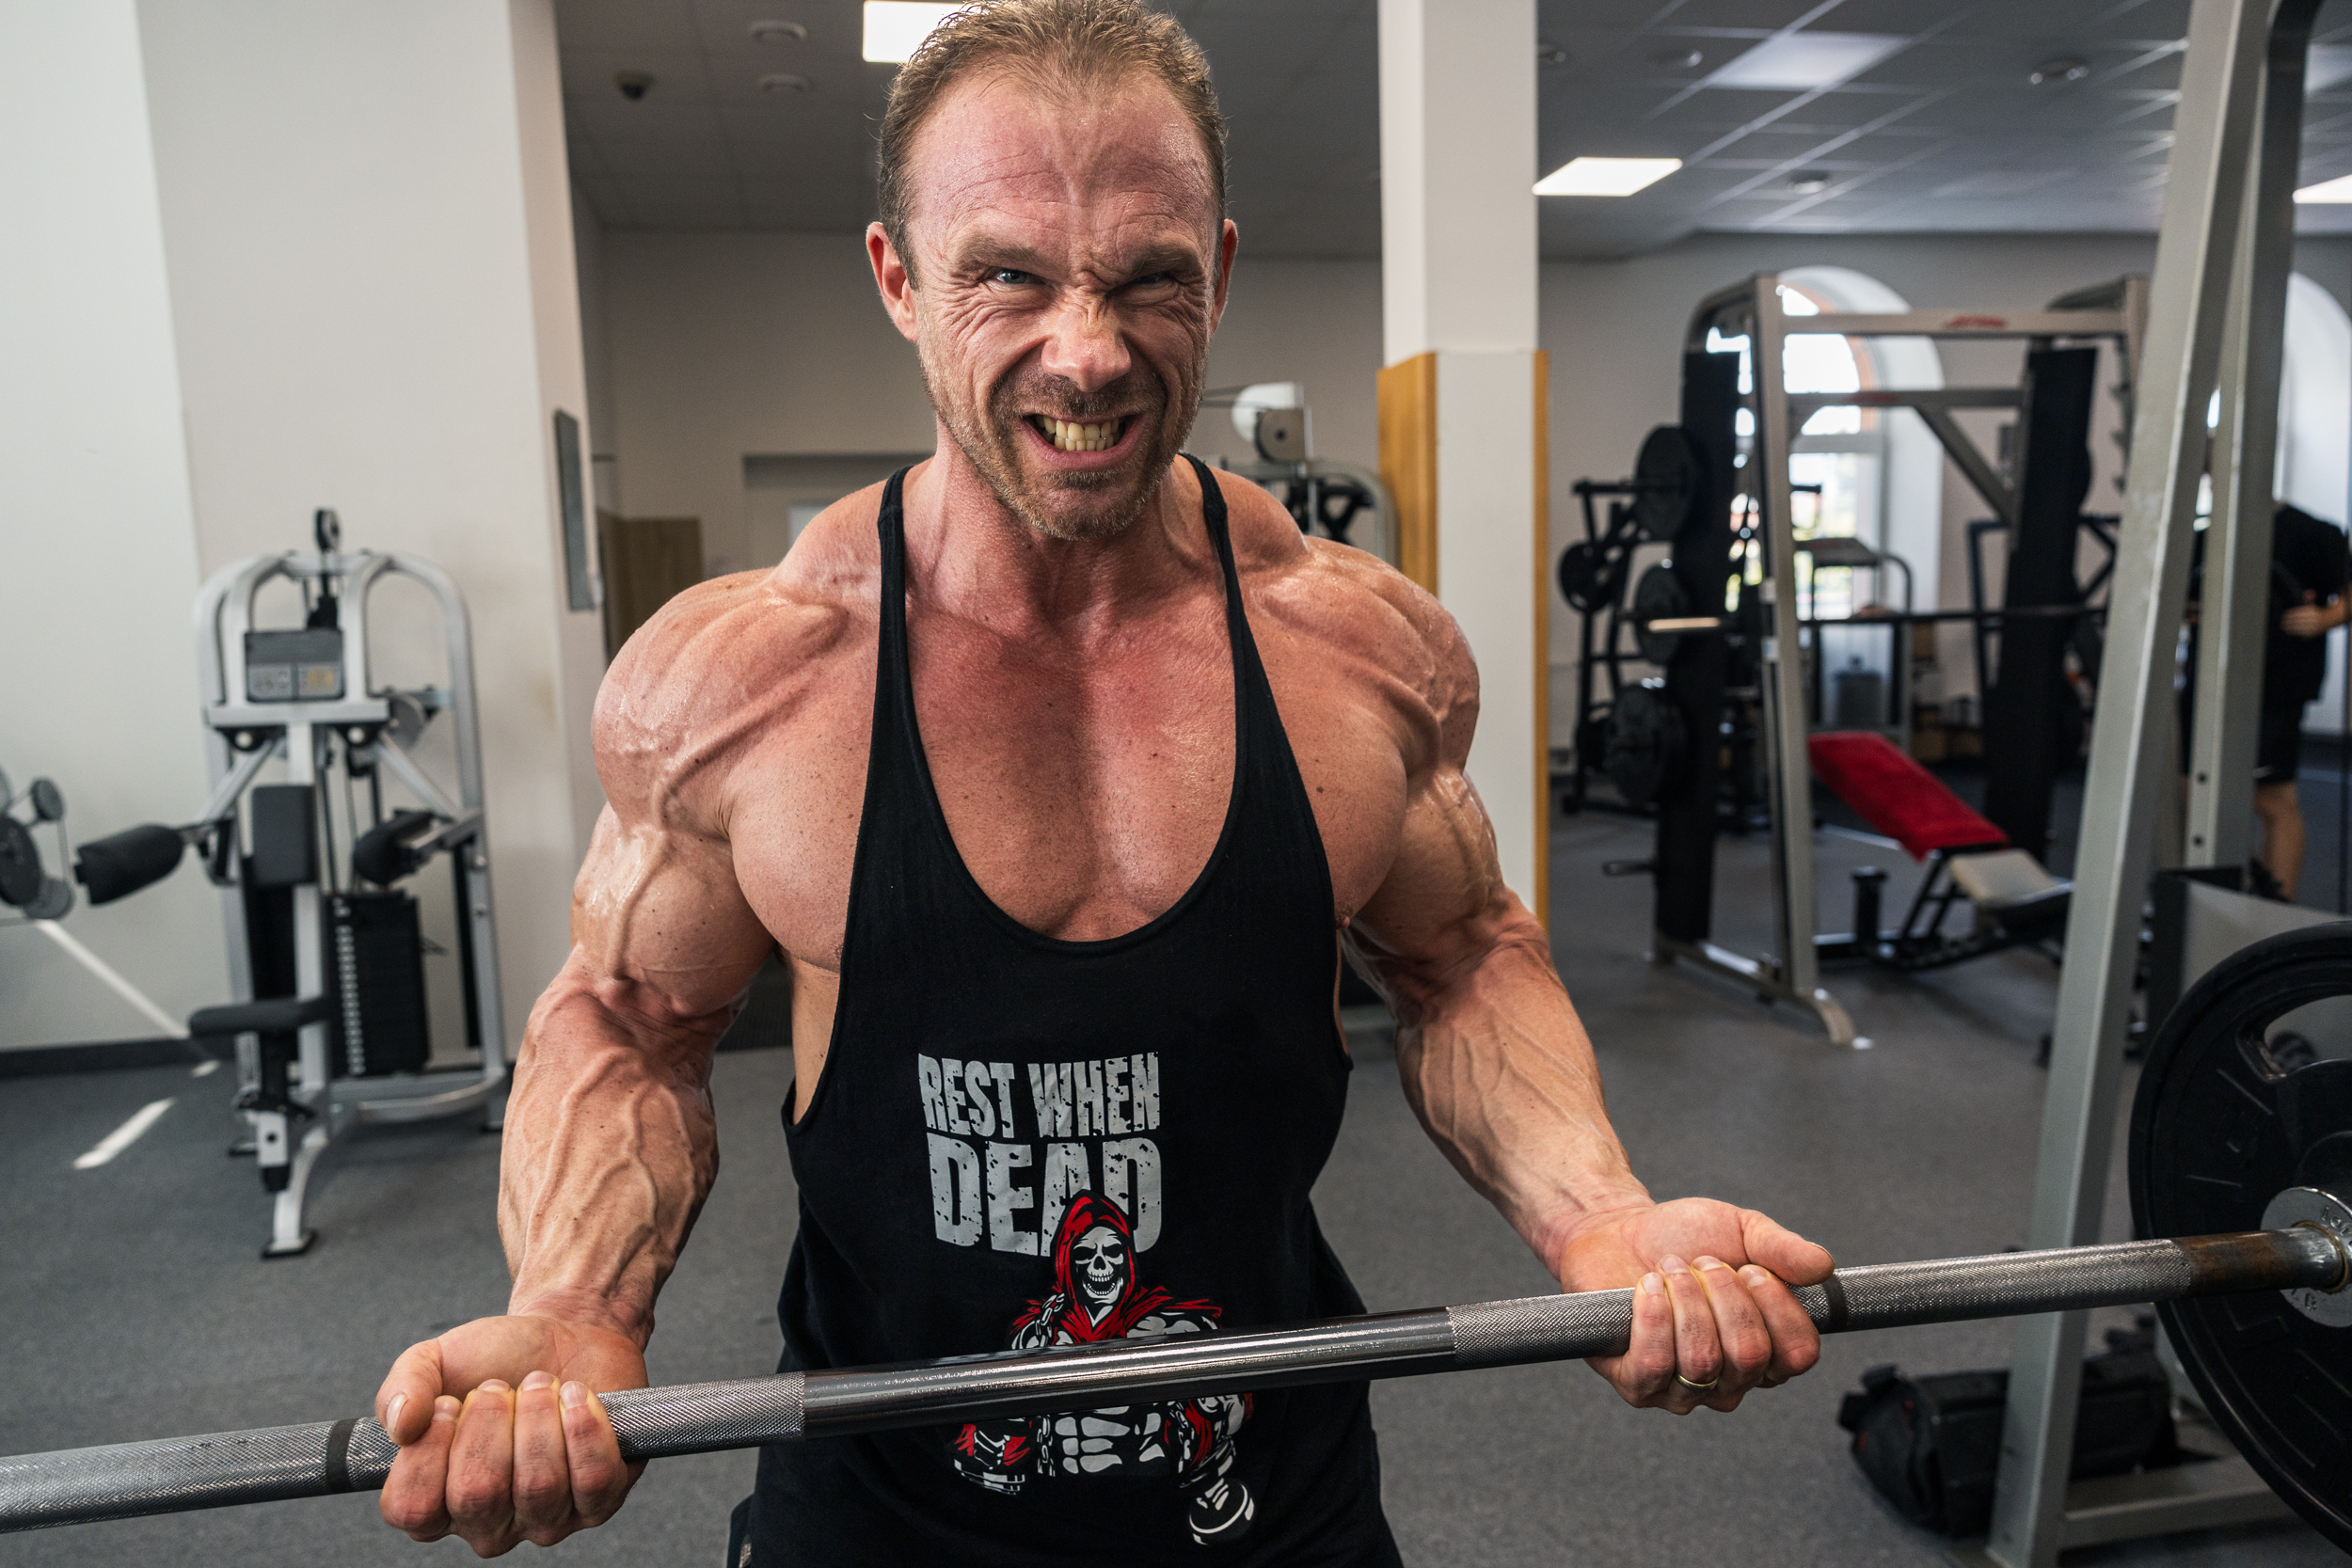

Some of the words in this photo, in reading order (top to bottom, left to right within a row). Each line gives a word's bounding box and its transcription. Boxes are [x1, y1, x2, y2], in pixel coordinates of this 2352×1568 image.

[918, 1053, 1015, 1138] REST
[1027, 1052, 1161, 1138] WHEN
[926, 1132, 1163, 1258] DEAD
